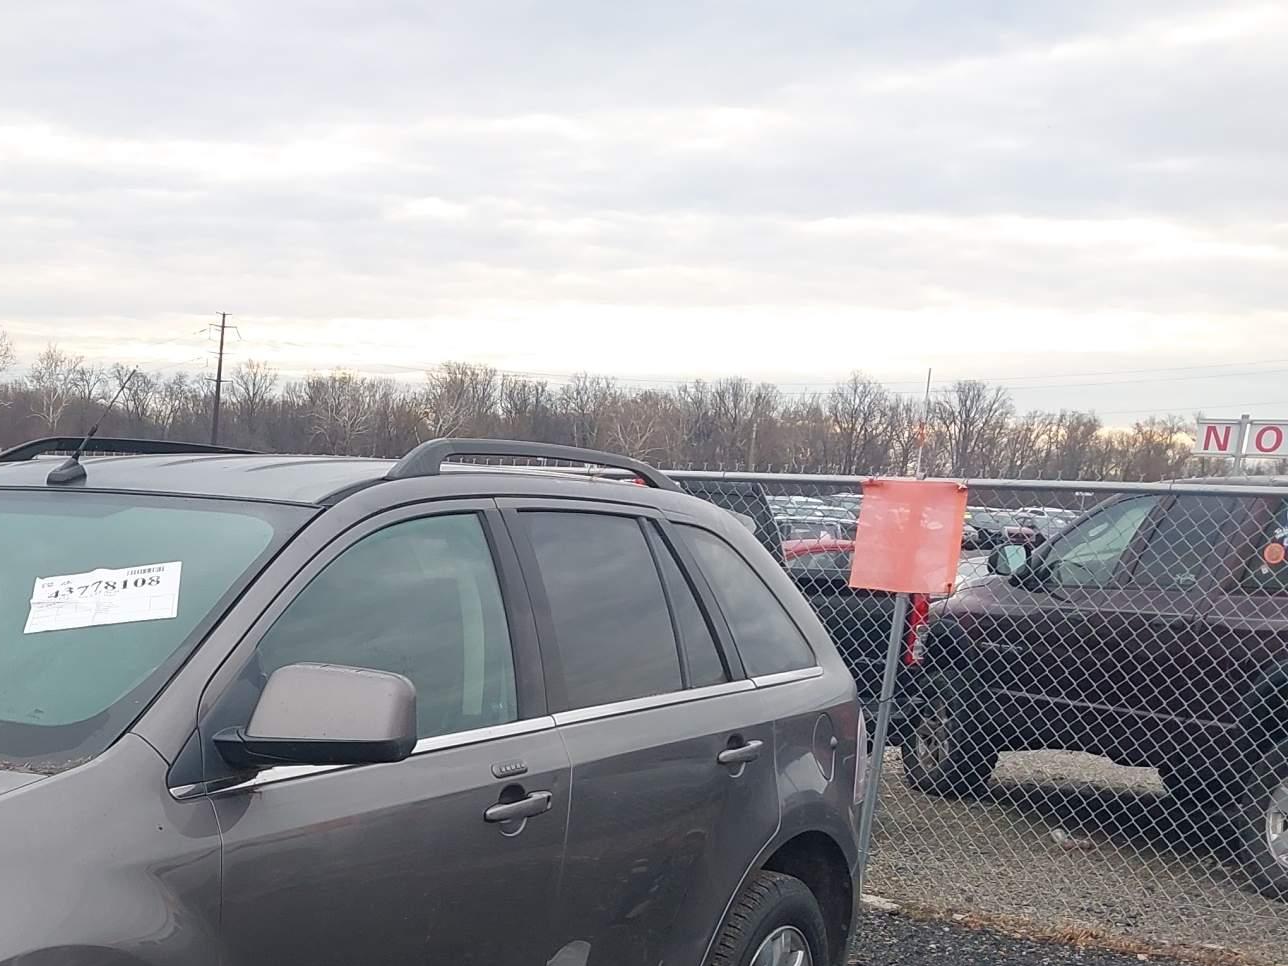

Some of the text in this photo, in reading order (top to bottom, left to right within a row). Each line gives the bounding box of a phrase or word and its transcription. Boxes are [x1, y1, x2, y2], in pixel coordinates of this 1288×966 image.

[1202, 425, 1283, 453] N O
[47, 575, 161, 599] 43778108
